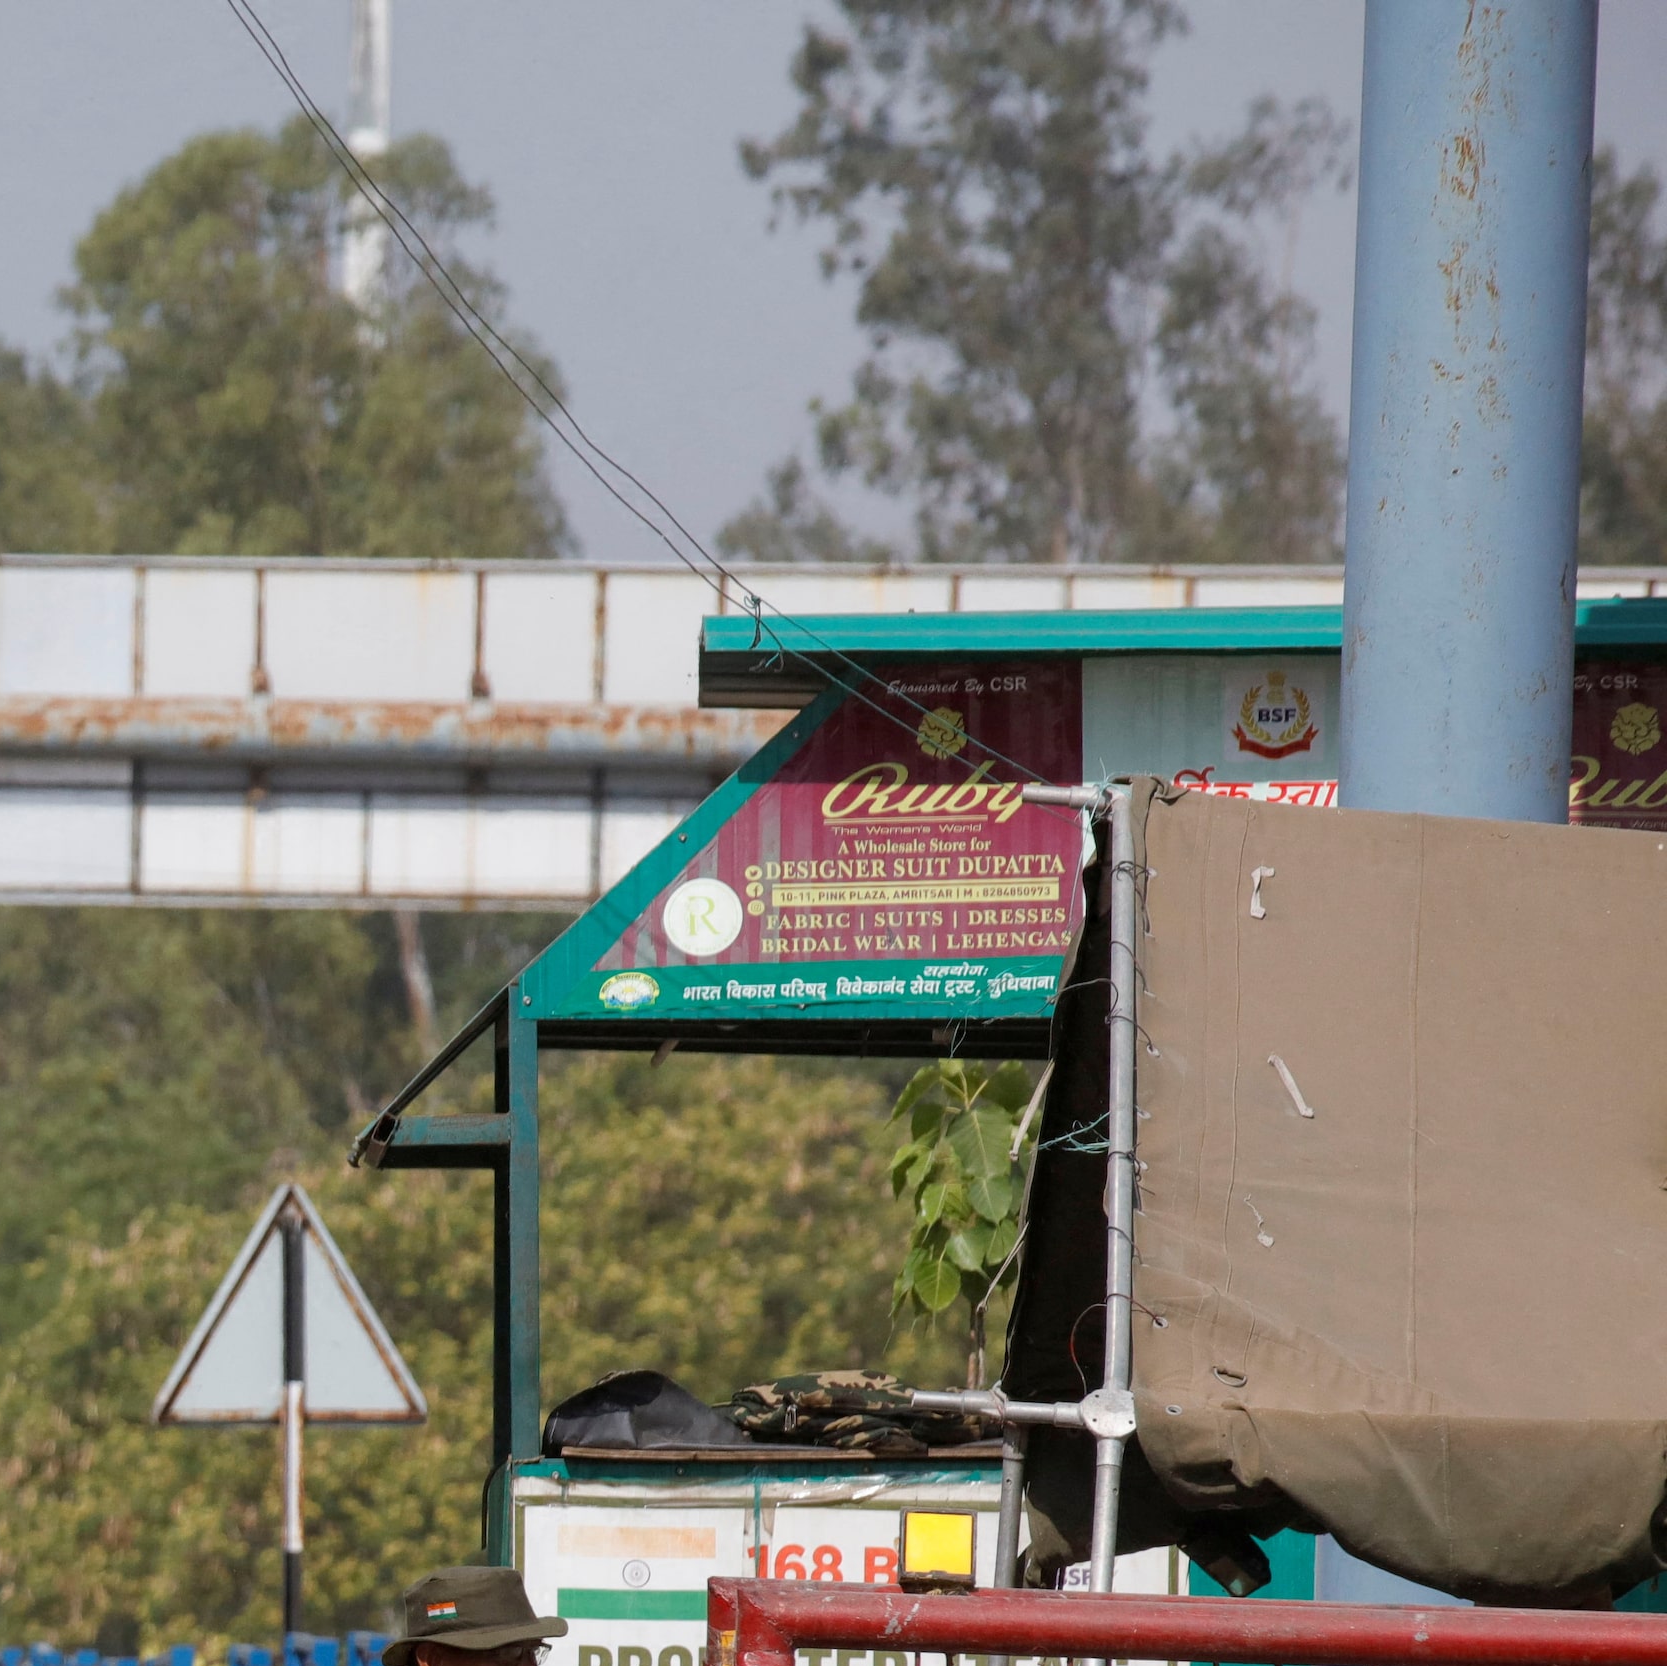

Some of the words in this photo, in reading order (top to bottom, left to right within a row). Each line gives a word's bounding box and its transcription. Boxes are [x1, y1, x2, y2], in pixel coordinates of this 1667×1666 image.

[964, 678, 985, 696] By
[989, 676, 1028, 692] CSR
[1600, 674, 1639, 690] CSR
[1257, 707, 1297, 723] BSF
[821, 759, 1043, 824] Ruby
[831, 825, 859, 837] The
[866, 824, 932, 836] Women's
[938, 822, 983, 834] World
[837, 841, 850, 855] A
[853, 839, 926, 855] Wholesale
[929, 837, 967, 852] Store
[970, 835, 993, 851] for
[764, 858, 887, 881] DESIGNER
[892, 856, 952, 878] SUIT
[957, 854, 1067, 877] DUPATTA
[818, 889, 846, 902] PINK
[849, 888, 891, 902] PLAZA,
[893, 887, 954, 901] AMRITSAR
[963, 887, 974, 898] M
[766, 912, 852, 931] FABRIC
[873, 909, 945, 928] SUITS
[968, 906, 1067, 926] DRESSES
[760, 936, 848, 954] BRIDAL
[854, 932, 923, 951] WEAR
[947, 930, 1073, 950] LEHENGAS
[683, 984, 723, 1001] भारत
[726, 979, 777, 1001] विकास
[909, 974, 941, 996] सेवा
